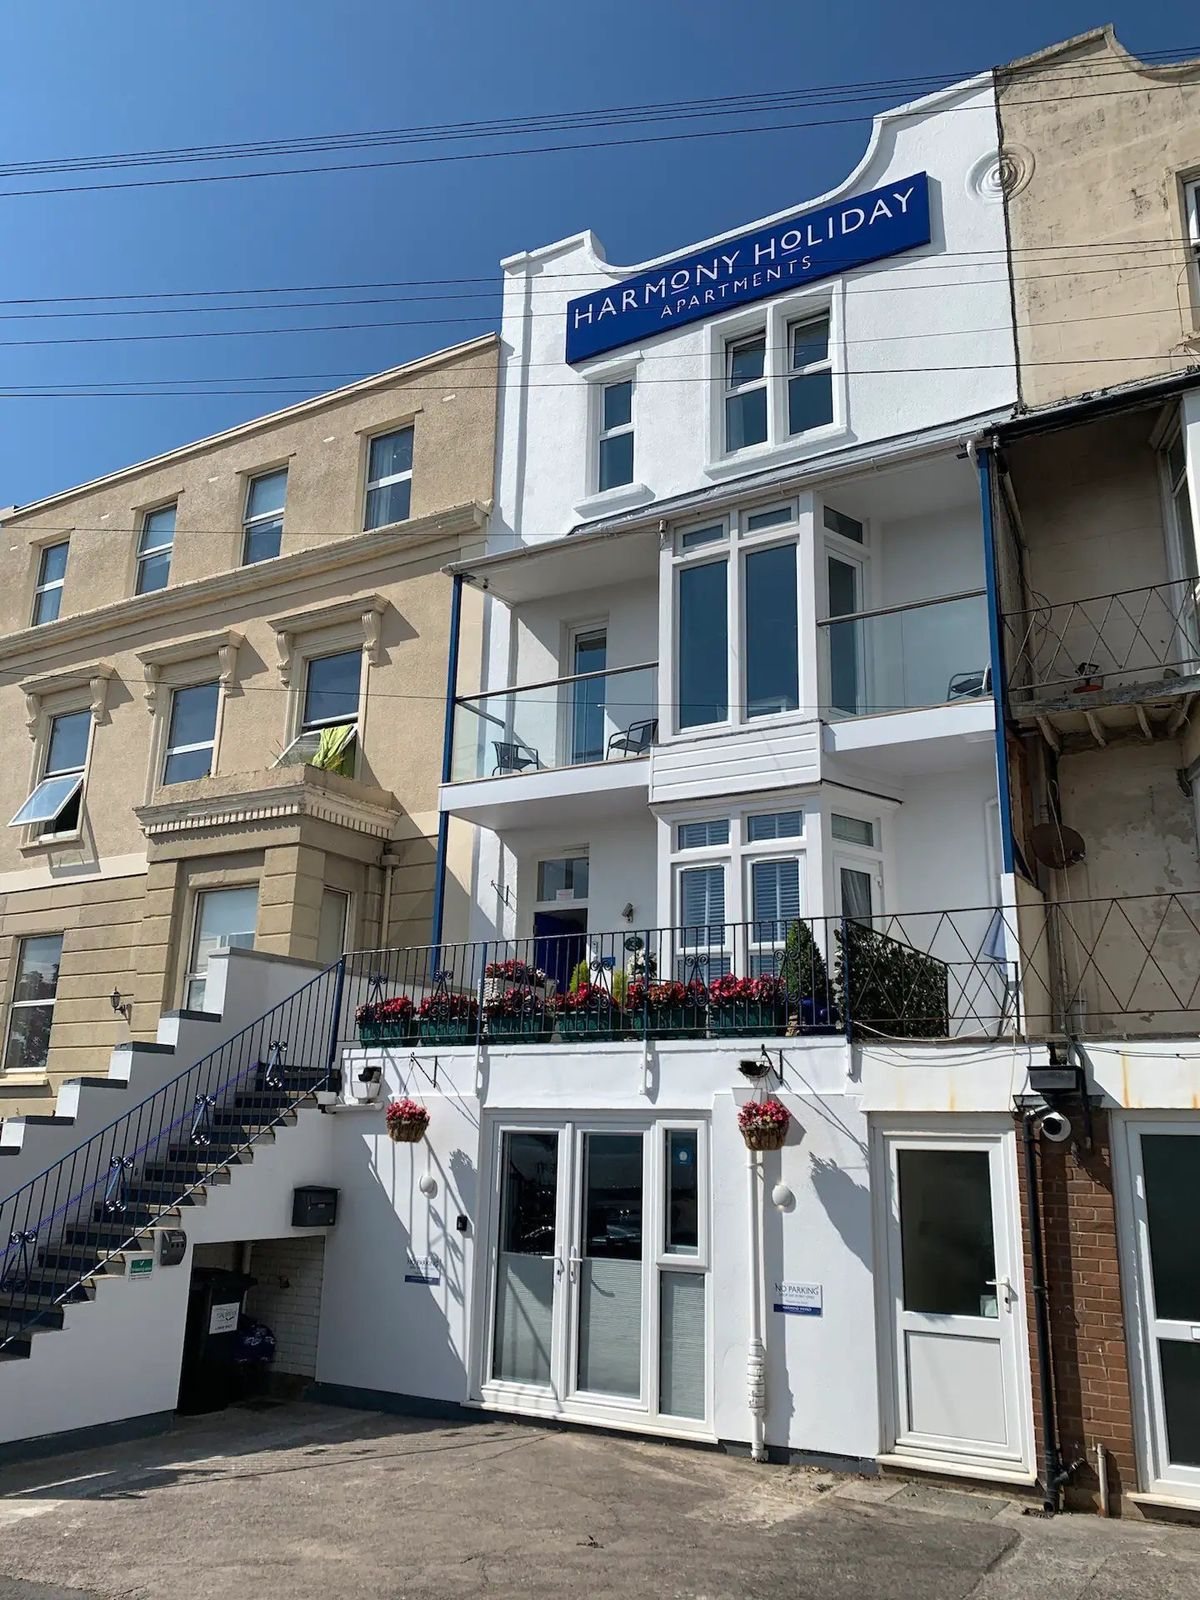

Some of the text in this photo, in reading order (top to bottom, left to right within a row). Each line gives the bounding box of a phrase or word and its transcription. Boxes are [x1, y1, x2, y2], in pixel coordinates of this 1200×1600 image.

[574, 186, 915, 329] HARMONY HOLIDAY
[660, 255, 812, 319] APARTMENTS
[775, 1282, 819, 1295] NO PARKING
